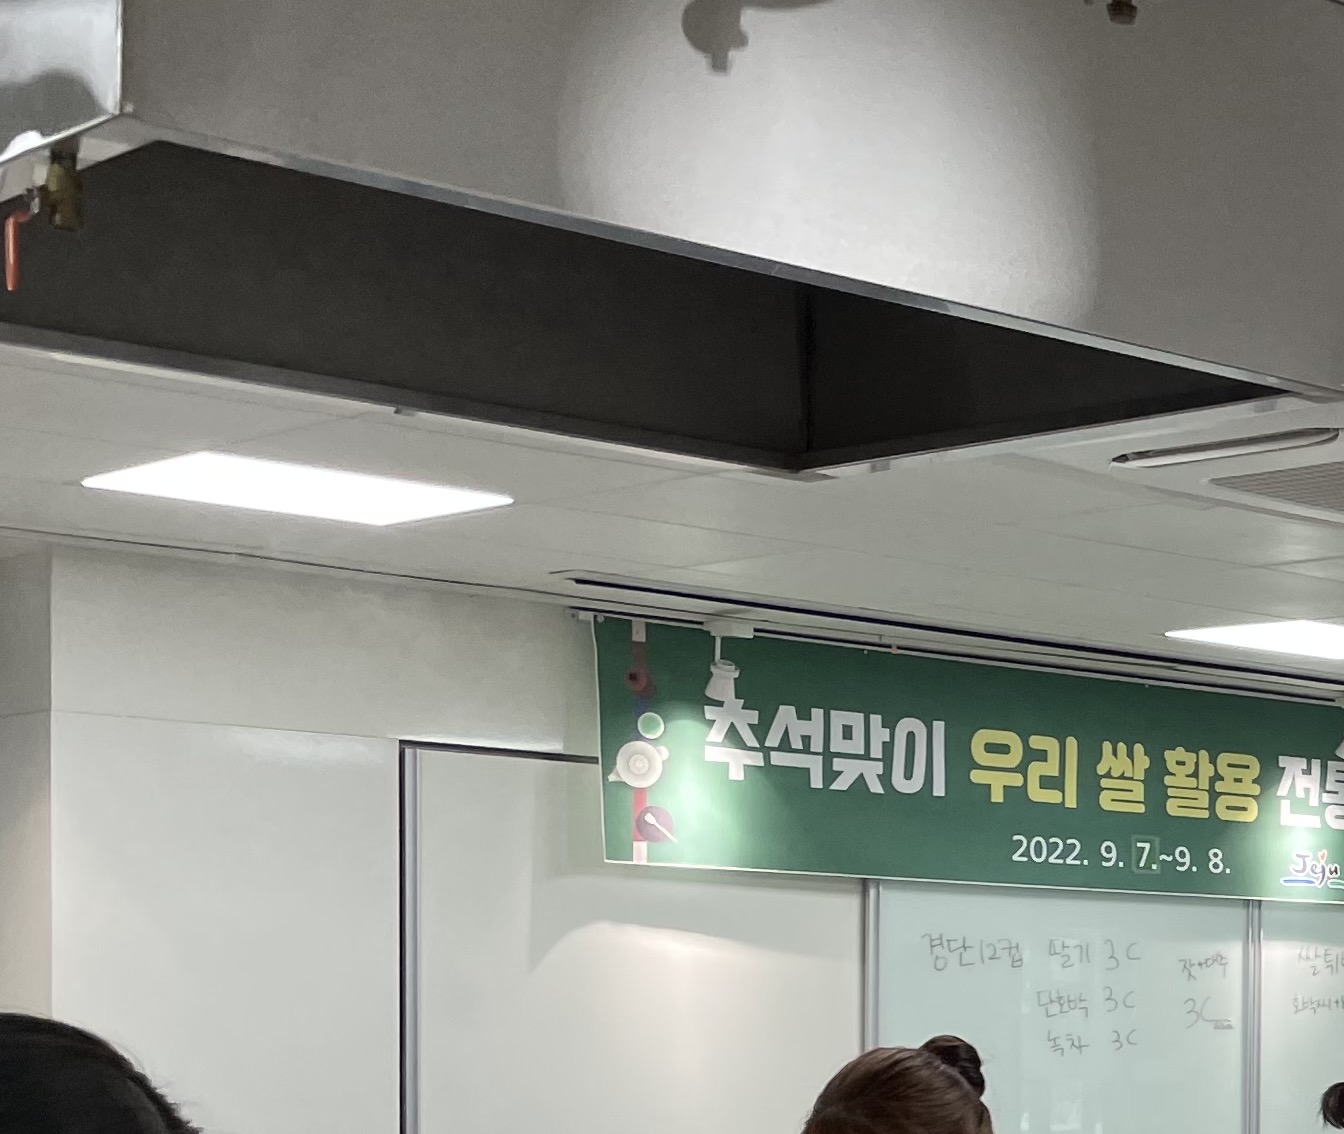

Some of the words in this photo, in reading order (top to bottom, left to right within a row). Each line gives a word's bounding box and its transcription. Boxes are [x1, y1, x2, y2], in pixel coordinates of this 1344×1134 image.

[704, 696, 947, 797] 추석맞이
[970, 729, 1079, 808] 우리
[1096, 741, 1150, 814] 쌀
[1163, 747, 1261, 822] 활용
[1011, 835, 1089, 866] 2022.
[1100, 841, 1125, 868] 9.
[1208, 848, 1231, 874] 8.
